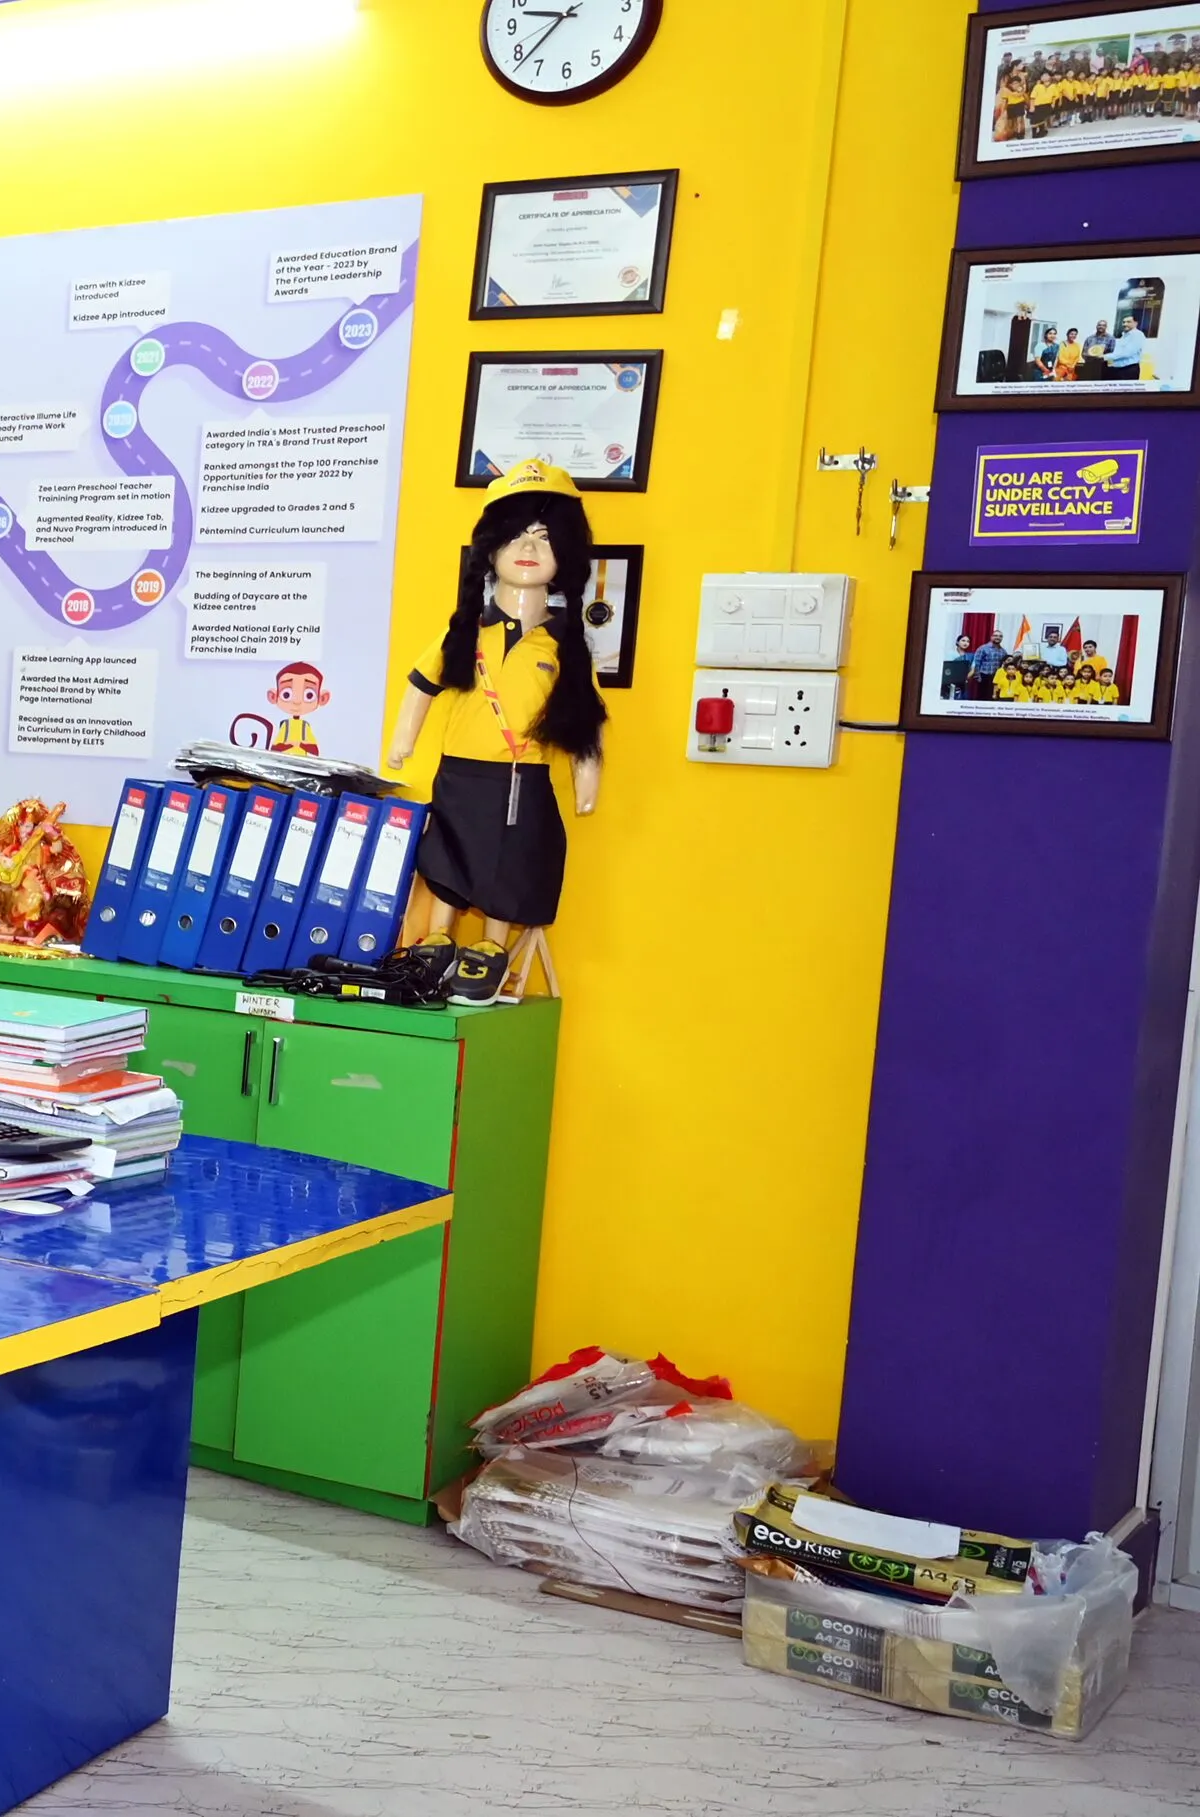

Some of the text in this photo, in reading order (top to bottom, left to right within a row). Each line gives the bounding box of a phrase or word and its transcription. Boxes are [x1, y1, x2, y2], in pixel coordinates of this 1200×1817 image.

[621, 0, 632, 12] 3
[506, 18, 517, 35] 9
[613, 25, 624, 42] 4
[513, 44, 523, 61] 8
[591, 50, 601, 67] 5
[534, 59, 544, 76] 7
[561, 62, 572, 79] 6
[518, 210, 559, 220] CERTIFICATE
[571, 208, 621, 217] APPRECIATION
[276, 244, 397, 263] Awarded Education Brand
[332, 259, 355, 269] 2023
[292, 268, 383, 284] Fortune Leadership
[74, 278, 146, 291] Learn with Kidzee
[273, 286, 309, 296] Awards
[73, 290, 120, 301] introduced
[72, 307, 166, 321] Kidzee App introduced
[344, 324, 372, 338] 2023
[136, 351, 159, 364] 2021
[248, 375, 273, 388] 2022
[44, 421, 65, 429] Work
[205, 423, 386, 438] Awarded Most Trusted Preschool
[204, 435, 368, 451] category Brand Trust Report
[203, 456, 379, 471] Ranked amongst Top Franchise
[202, 469, 340, 483] Opportunities year 2022
[987, 472, 1063, 486] YOU ARE
[76, 482, 118, 491] Preschool
[118, 481, 152, 490] Teacher
[202, 482, 270, 492] Franchise India
[79, 493, 115, 503] Program
[140, 491, 171, 500] motion
[986, 486, 1097, 502] UNDER CCTV
[200, 502, 348, 515] Kidzee upgraded Grades and
[984, 501, 1112, 517] SURVEILLANCE
[36, 514, 84, 525] Augmented
[116, 513, 144, 521] Kidzee
[74, 524, 111, 534] Program
[111, 523, 158, 532] introduced
[248, 525, 300, 534] Curriculum
[300, 524, 345, 533] launched
[34, 535, 74, 543] Preschool
[212, 570, 312, 581] beginning Ankurum
[137, 580, 159, 594] 2019
[193, 591, 280, 602] Budding Daycare
[67, 599, 89, 613] 2018
[192, 602, 222, 610] Kidzee
[191, 623, 320, 635] Awarded National Early Child
[190, 634, 288, 644] playschool Chain 2019
[189, 644, 257, 654] Franchise India
[21, 654, 137, 665] Kidzee Learning App launced
[20, 674, 129, 685] Awarded Most Admired
[19, 684, 121, 695] Preschool Brand White
[18, 694, 92, 704] Page International
[17, 714, 132, 726] Recognised Innovation
[26, 724, 146, 737] Curriculum Early Childhood
[16, 734, 104, 746] Development ELETS
[242, 995, 280, 1008] WINTER
[754, 1524, 802, 1550] eco
[920, 1569, 948, 1582] A4
[822, 1618, 853, 1634] eco
[815, 1632, 832, 1643] A4
[822, 1653, 854, 1668] eco
